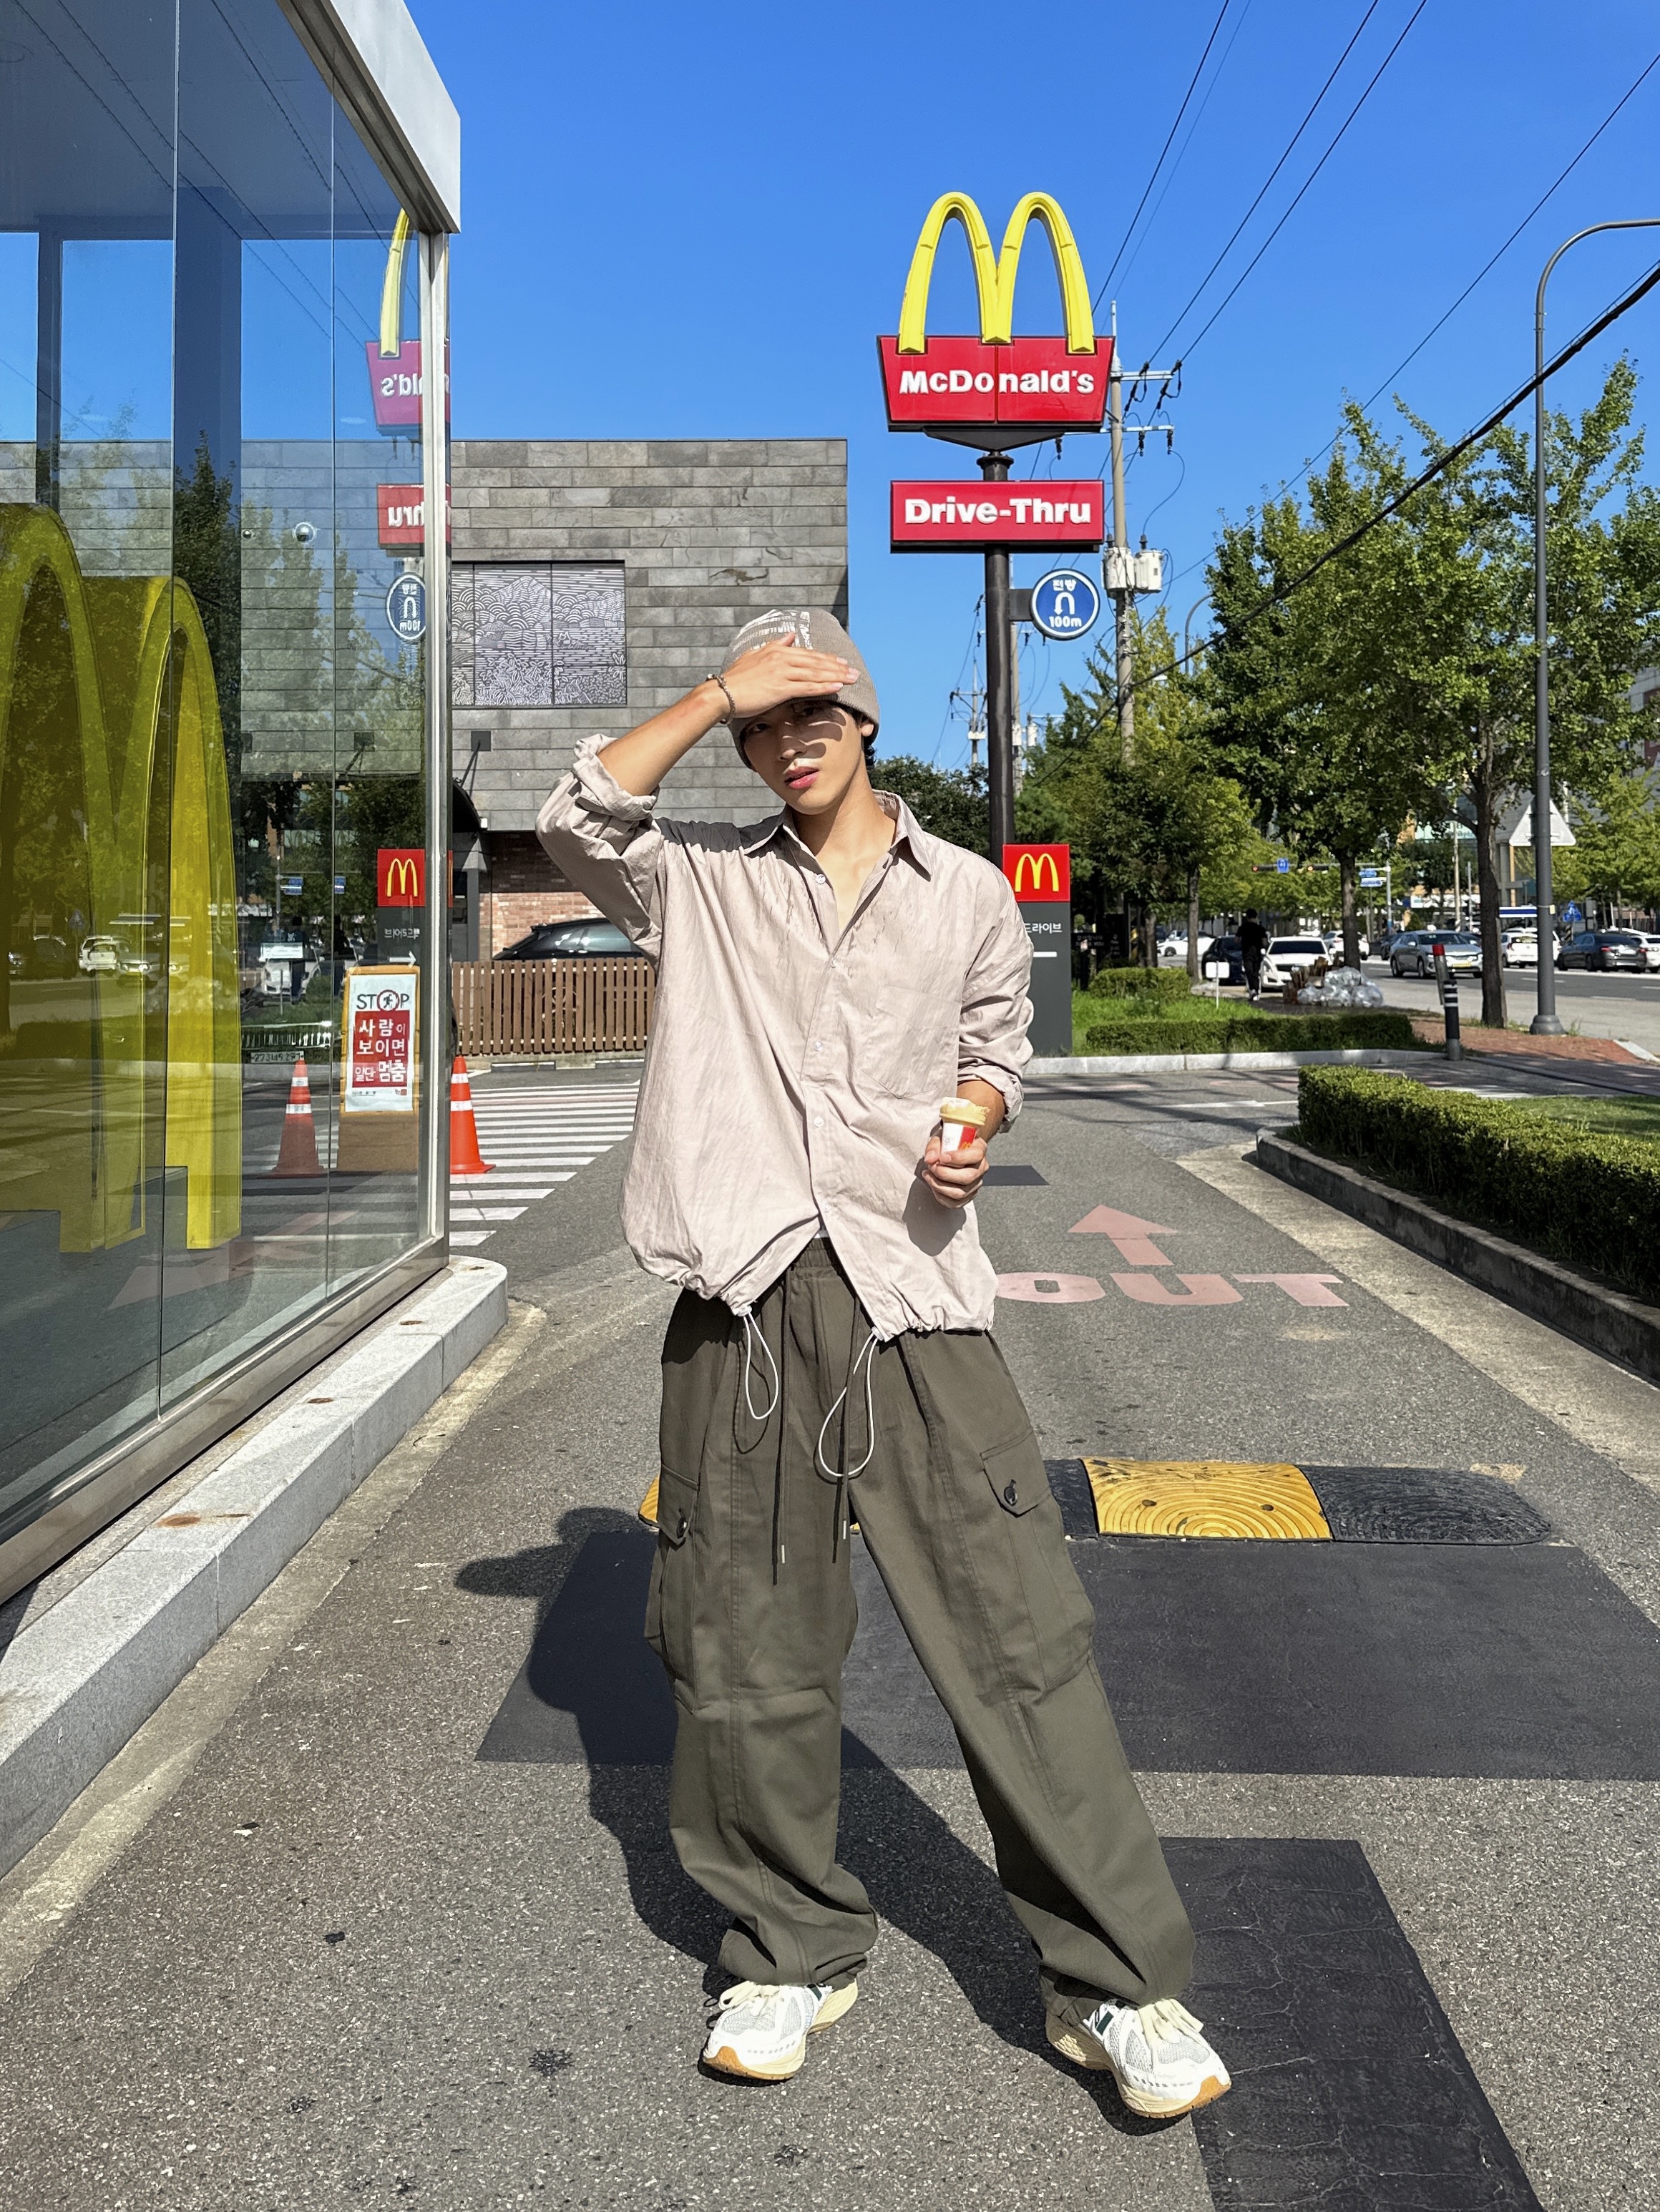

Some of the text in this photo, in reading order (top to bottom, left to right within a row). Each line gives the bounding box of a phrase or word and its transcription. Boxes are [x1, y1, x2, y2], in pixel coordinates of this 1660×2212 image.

[899, 369, 1095, 394] McDonald's
[904, 496, 1091, 524] Drive-Thru
[1053, 579, 1077, 592] 전방
[1048, 615, 1082, 628] 100m
[356, 989, 410, 1011] STOP
[359, 1019, 406, 1037] 사람이
[356, 1039, 405, 1057] 보이면
[355, 1059, 406, 1082] 일단 멈춤
[997, 1271, 1350, 1307] OUT
